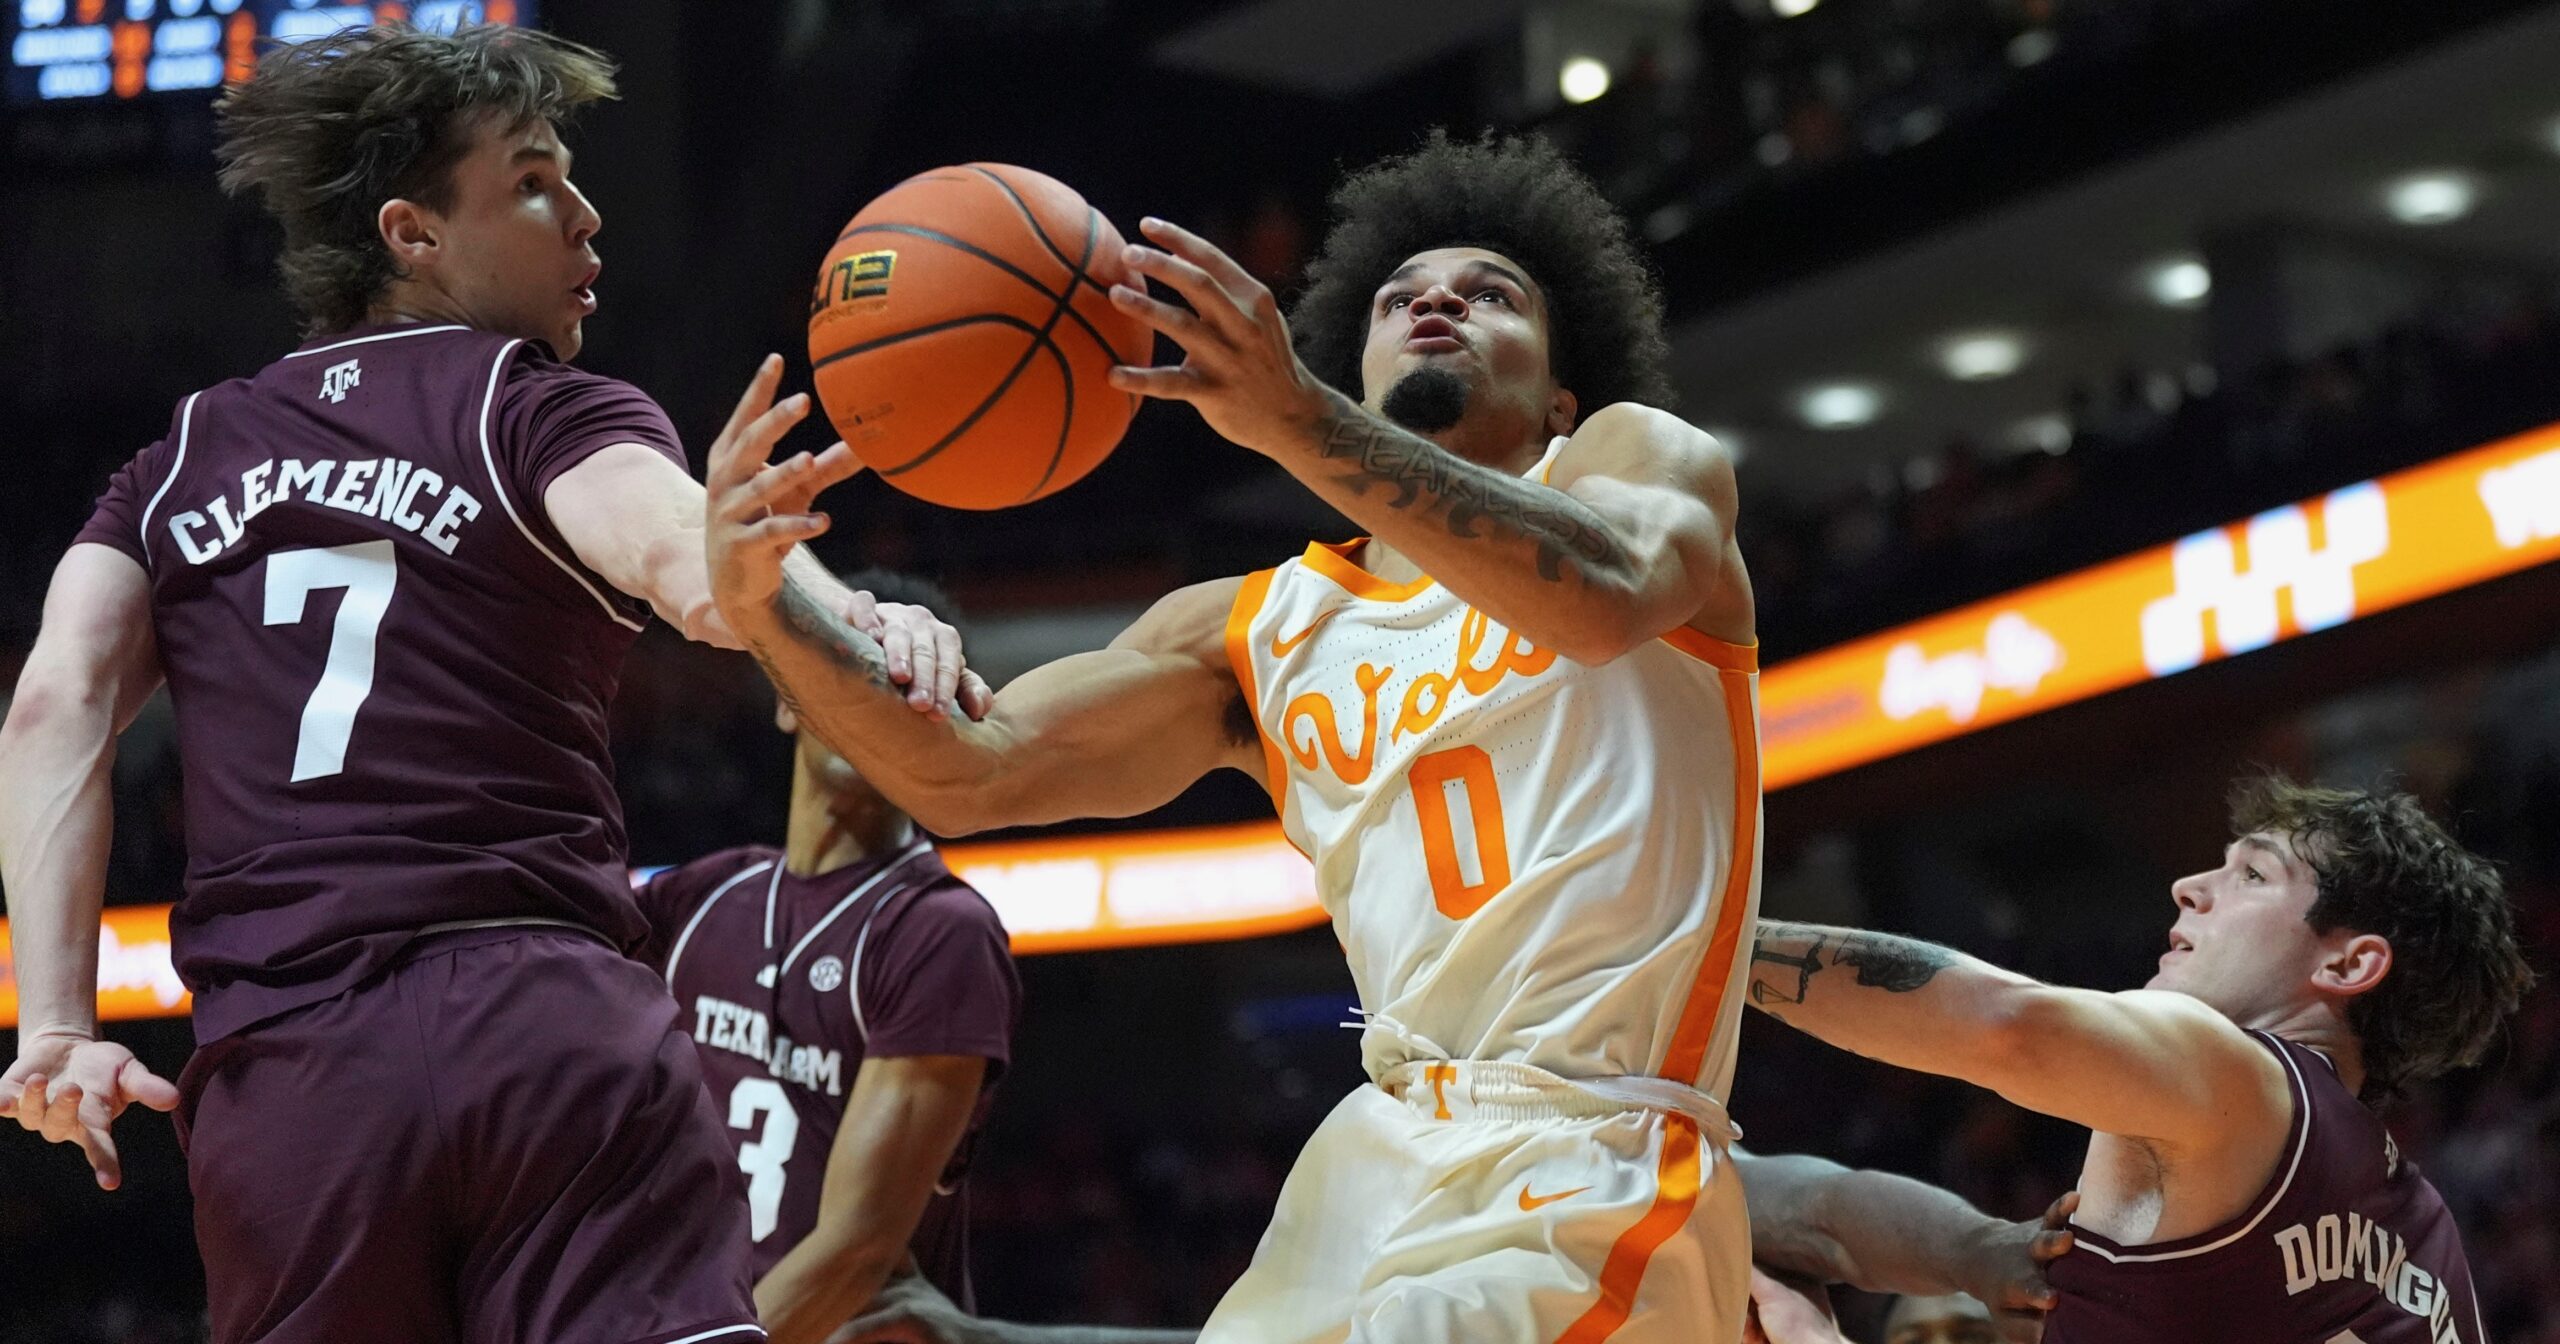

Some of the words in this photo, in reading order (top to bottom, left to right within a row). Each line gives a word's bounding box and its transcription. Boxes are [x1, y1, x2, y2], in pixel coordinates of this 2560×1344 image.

[168, 457, 482, 565] CLEMENCE
[263, 539, 398, 782] 7
[1407, 744, 1512, 921] 0
[1424, 1065, 1457, 1120] T
